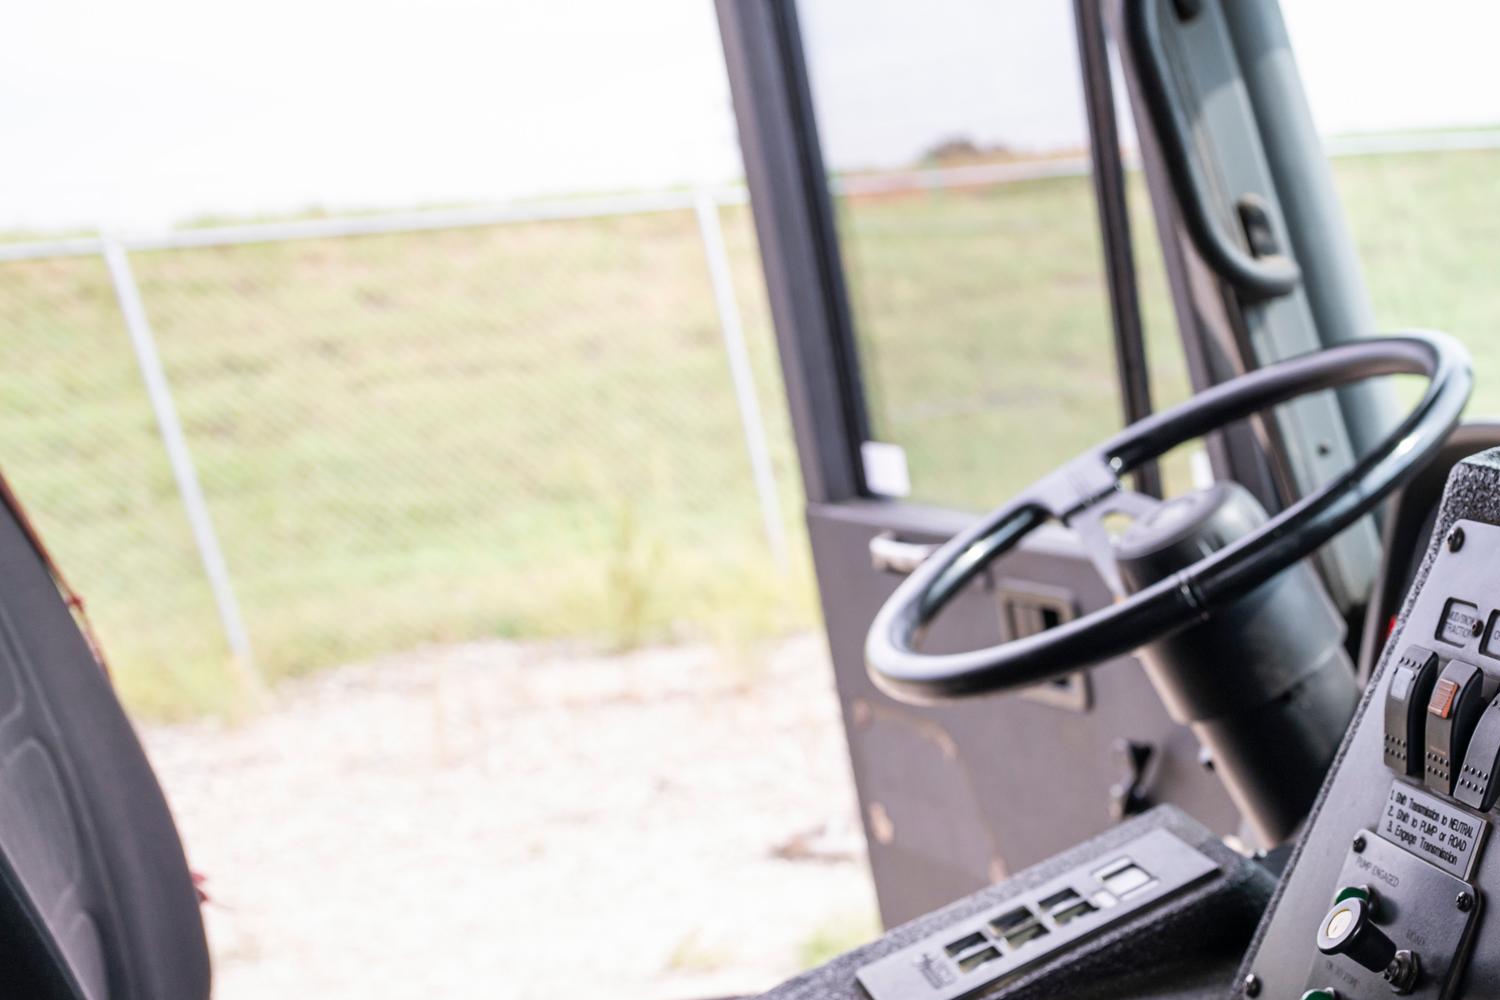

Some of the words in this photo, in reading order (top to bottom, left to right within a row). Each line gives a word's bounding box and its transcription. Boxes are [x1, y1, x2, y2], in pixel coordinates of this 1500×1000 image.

[1410, 798, 1440, 821] Transmission
[1448, 817, 1474, 838] NEUTRAL
[1419, 820, 1438, 837] PUMP
[1448, 833, 1467, 852] ROAD
[1395, 825, 1417, 845] Engage
[1420, 837, 1457, 865] Transmission
[1356, 856, 1371, 871] PUMP
[1372, 865, 1399, 887] ENGAGED
